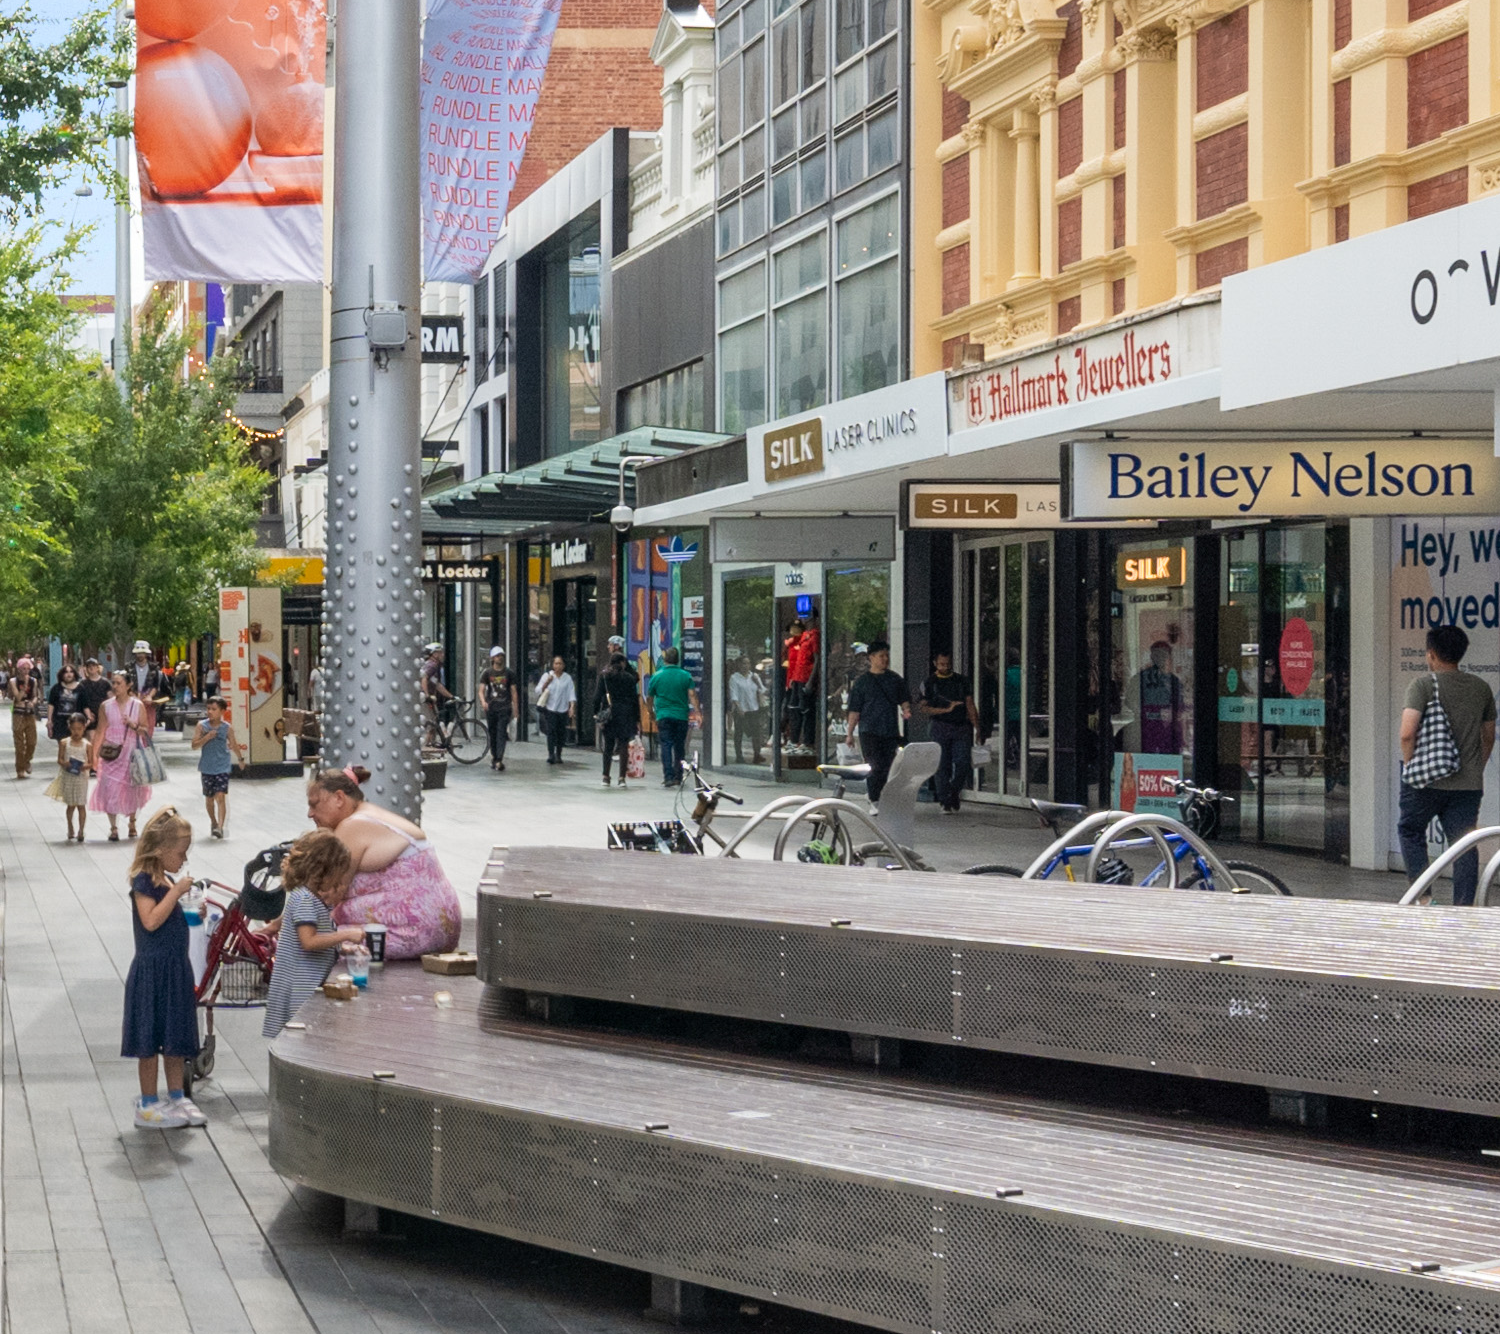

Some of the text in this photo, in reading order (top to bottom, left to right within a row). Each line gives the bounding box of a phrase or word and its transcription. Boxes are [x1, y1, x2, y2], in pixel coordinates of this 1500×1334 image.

[452, 51, 503, 71] RUNDLE
[507, 56, 547, 71] MALL
[440, 71, 502, 95] RUNDLE
[432, 95, 501, 122] RUNDLE
[428, 123, 500, 151] RUNDLE
[427, 152, 499, 181] RUNDLE
[430, 182, 499, 209] RUNDLE
[433, 210, 499, 233] RUNDLE
[987, 354, 1069, 422] Hallmark
[1074, 330, 1171, 402] Jewellers
[771, 409, 917, 469] SILK LASER CLINICS
[1107, 451, 1475, 512] Bailey Nelson
[931, 498, 1057, 514] SILK LAS
[1400, 523, 1460, 576] Hey,
[438, 564, 489, 578] Locker
[1125, 557, 1171, 582] SILK
[1139, 774, 1158, 792] 50%
